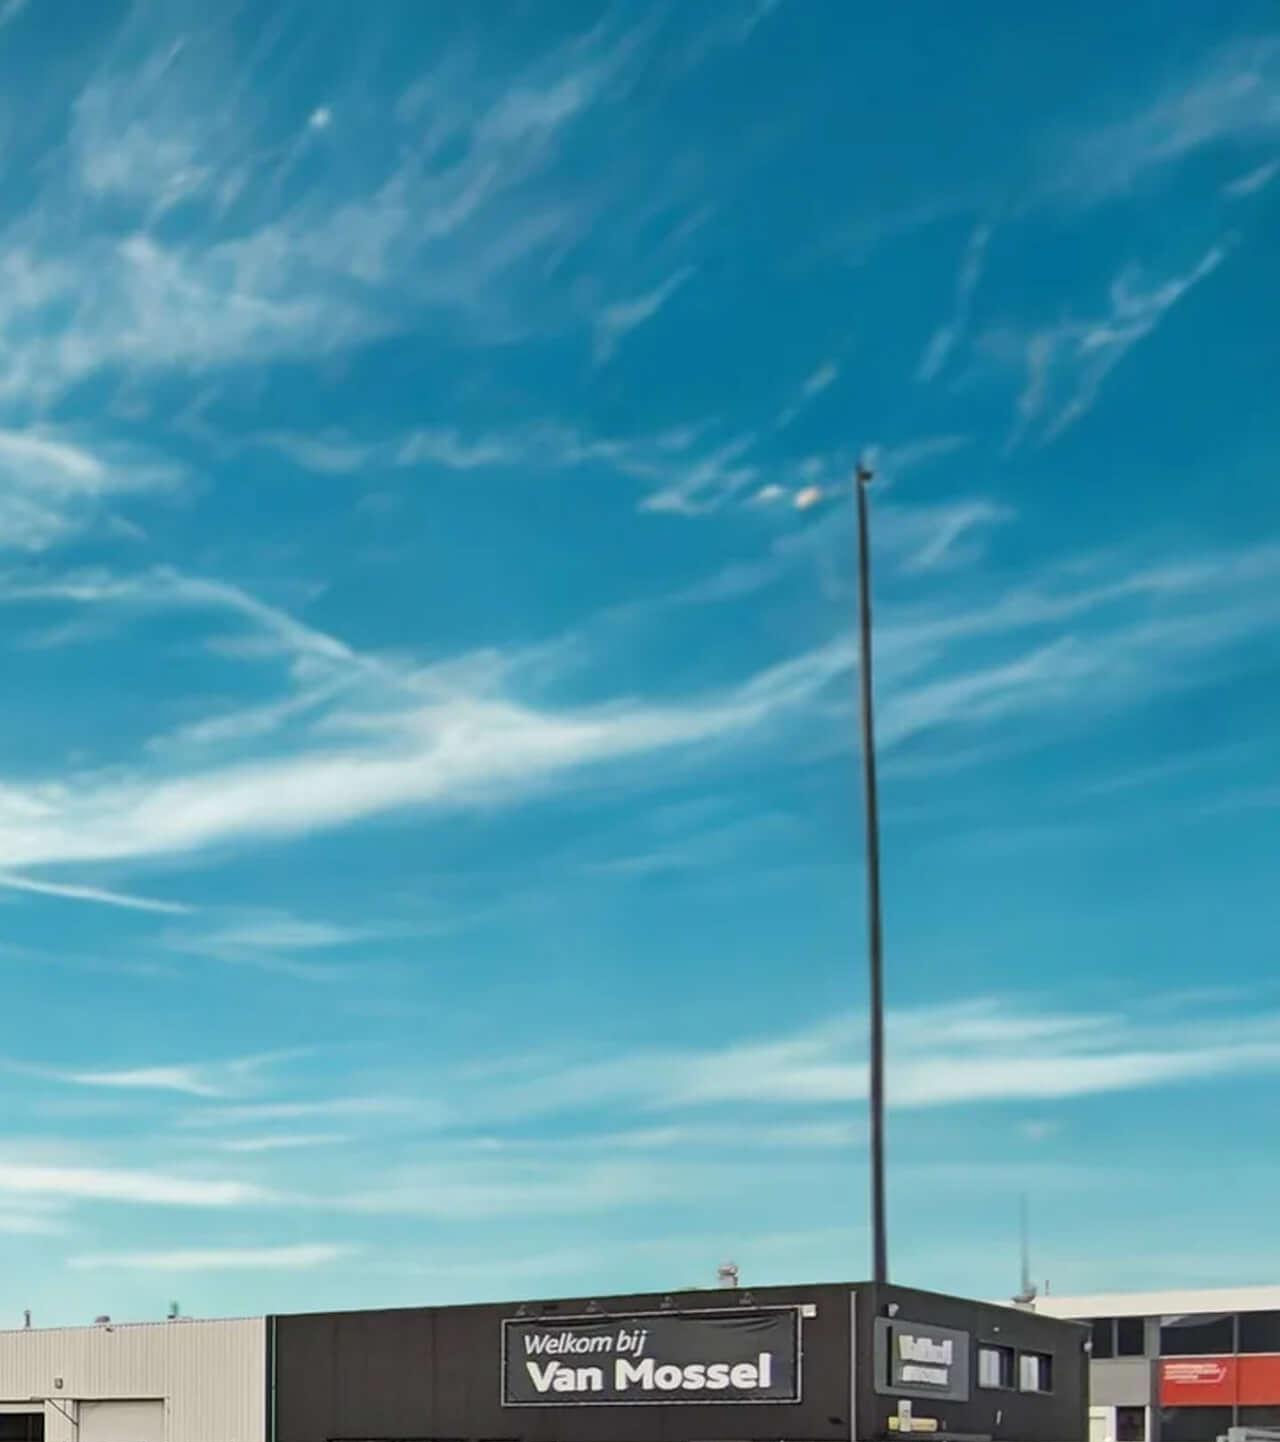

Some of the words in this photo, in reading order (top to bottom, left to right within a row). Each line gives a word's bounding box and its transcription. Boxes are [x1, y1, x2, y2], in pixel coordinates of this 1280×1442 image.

[524, 1334, 612, 1354] Welkom
[616, 1330, 647, 1356] bij
[526, 1361, 603, 1392] Van
[615, 1352, 771, 1391] Mossel
